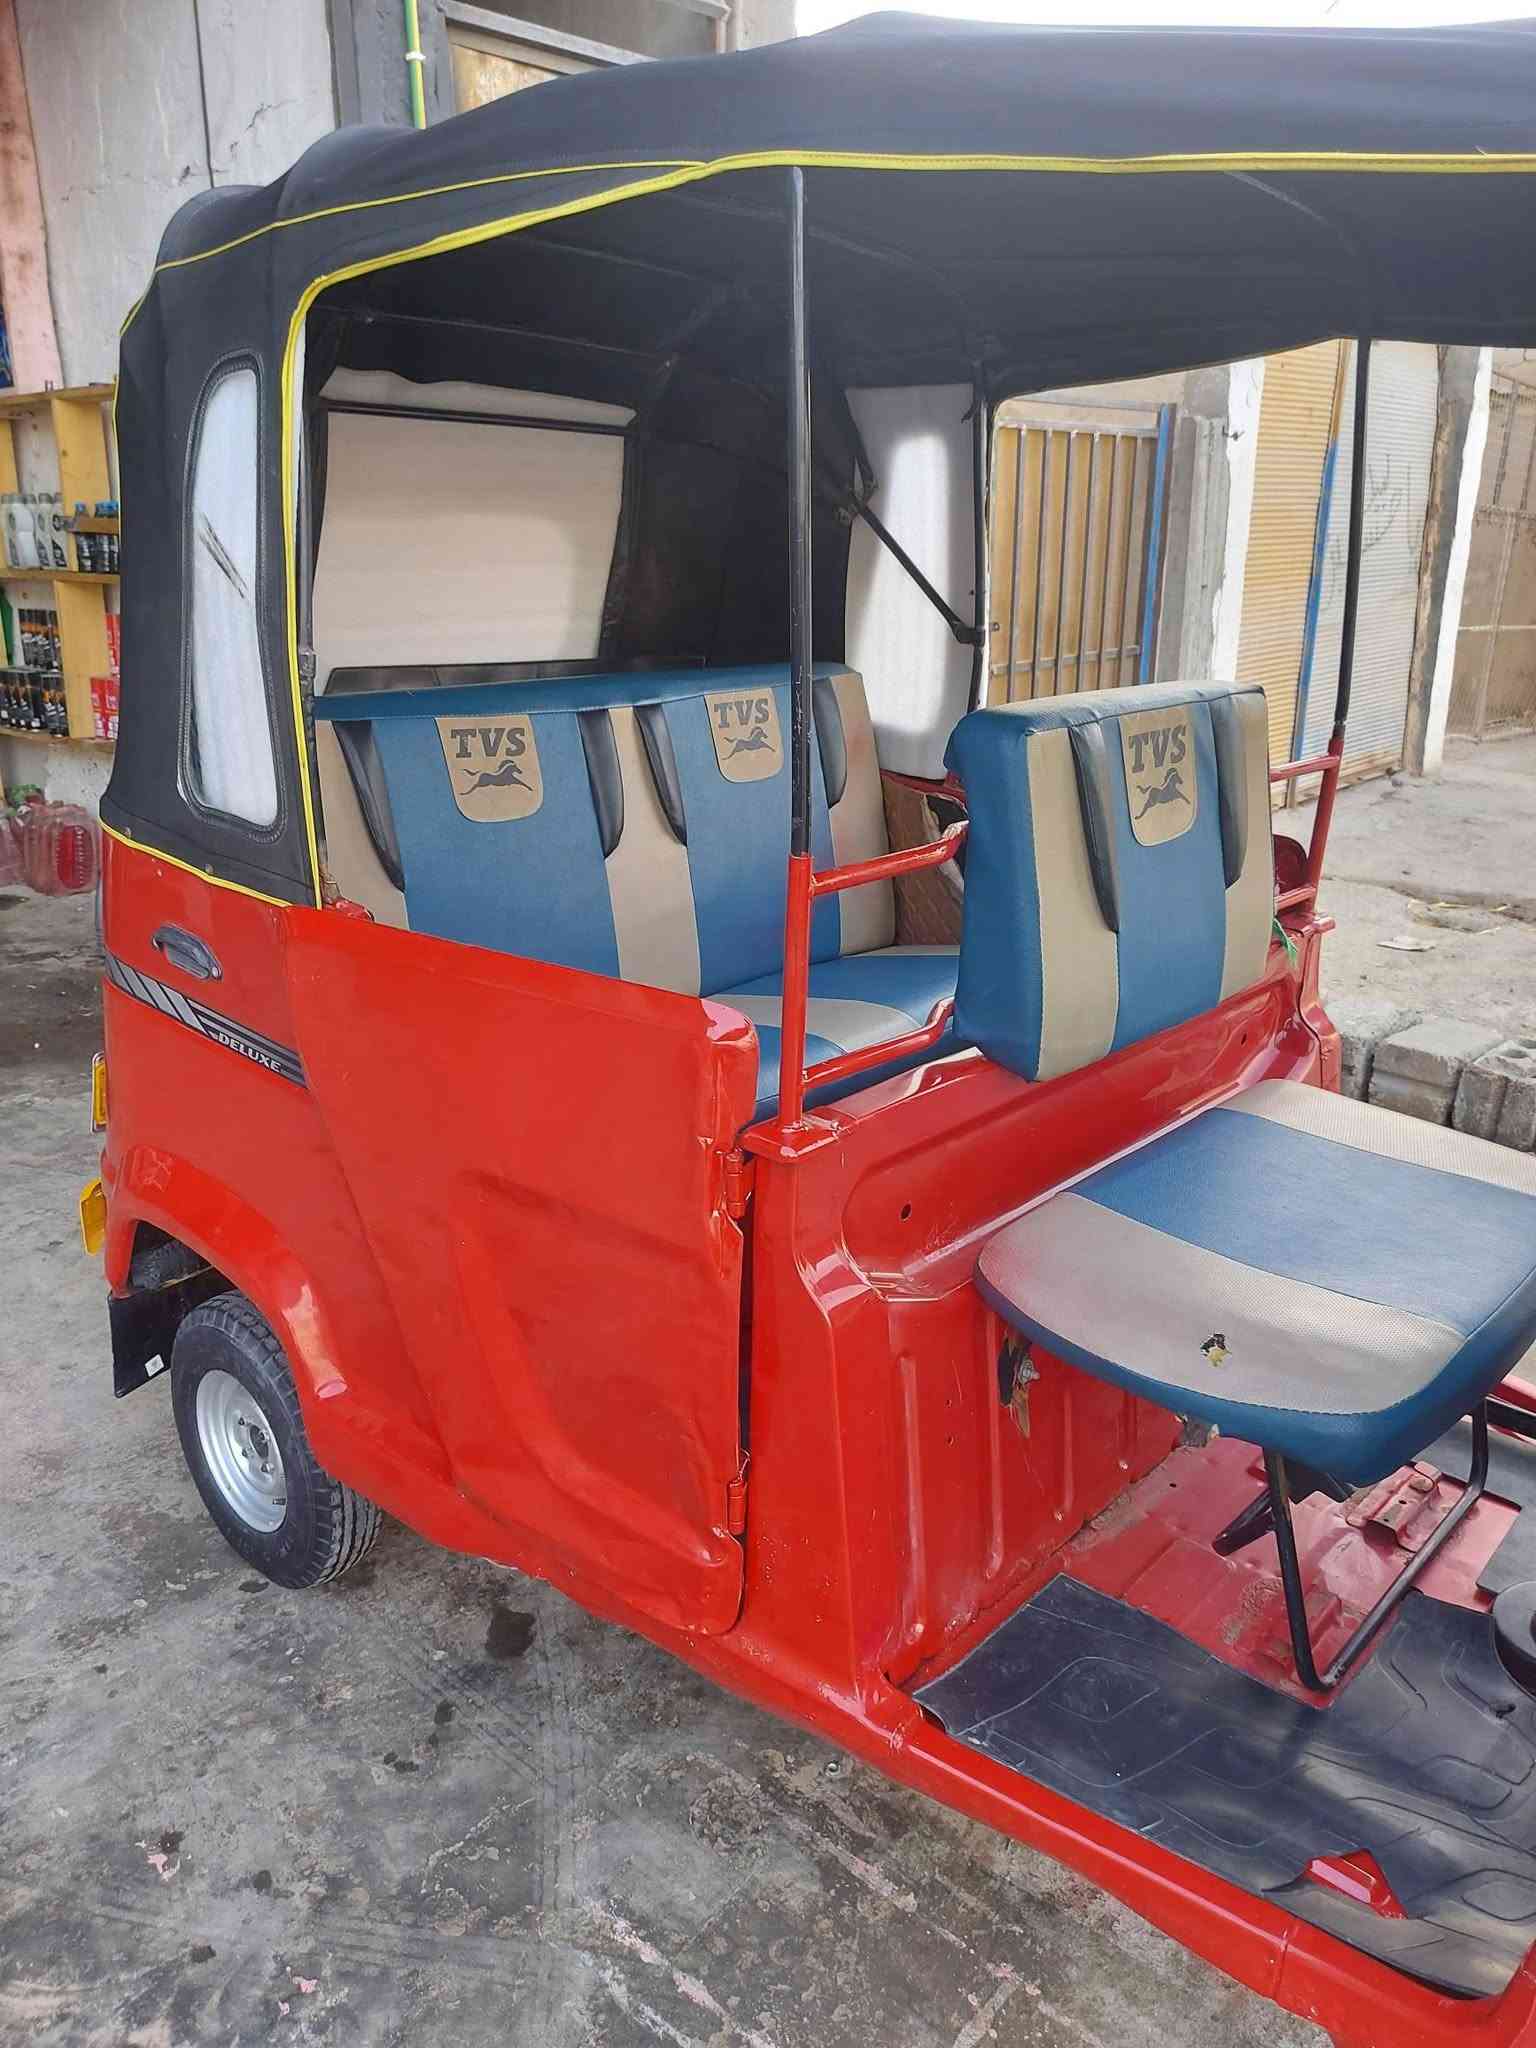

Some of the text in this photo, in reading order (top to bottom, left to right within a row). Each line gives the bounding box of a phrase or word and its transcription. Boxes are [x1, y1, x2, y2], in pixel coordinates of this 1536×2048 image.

[713, 697, 770, 730] TVS
[450, 726, 527, 759] TVS
[1128, 723, 1187, 774] TVS
[218, 1031, 282, 1073] DELUXE
